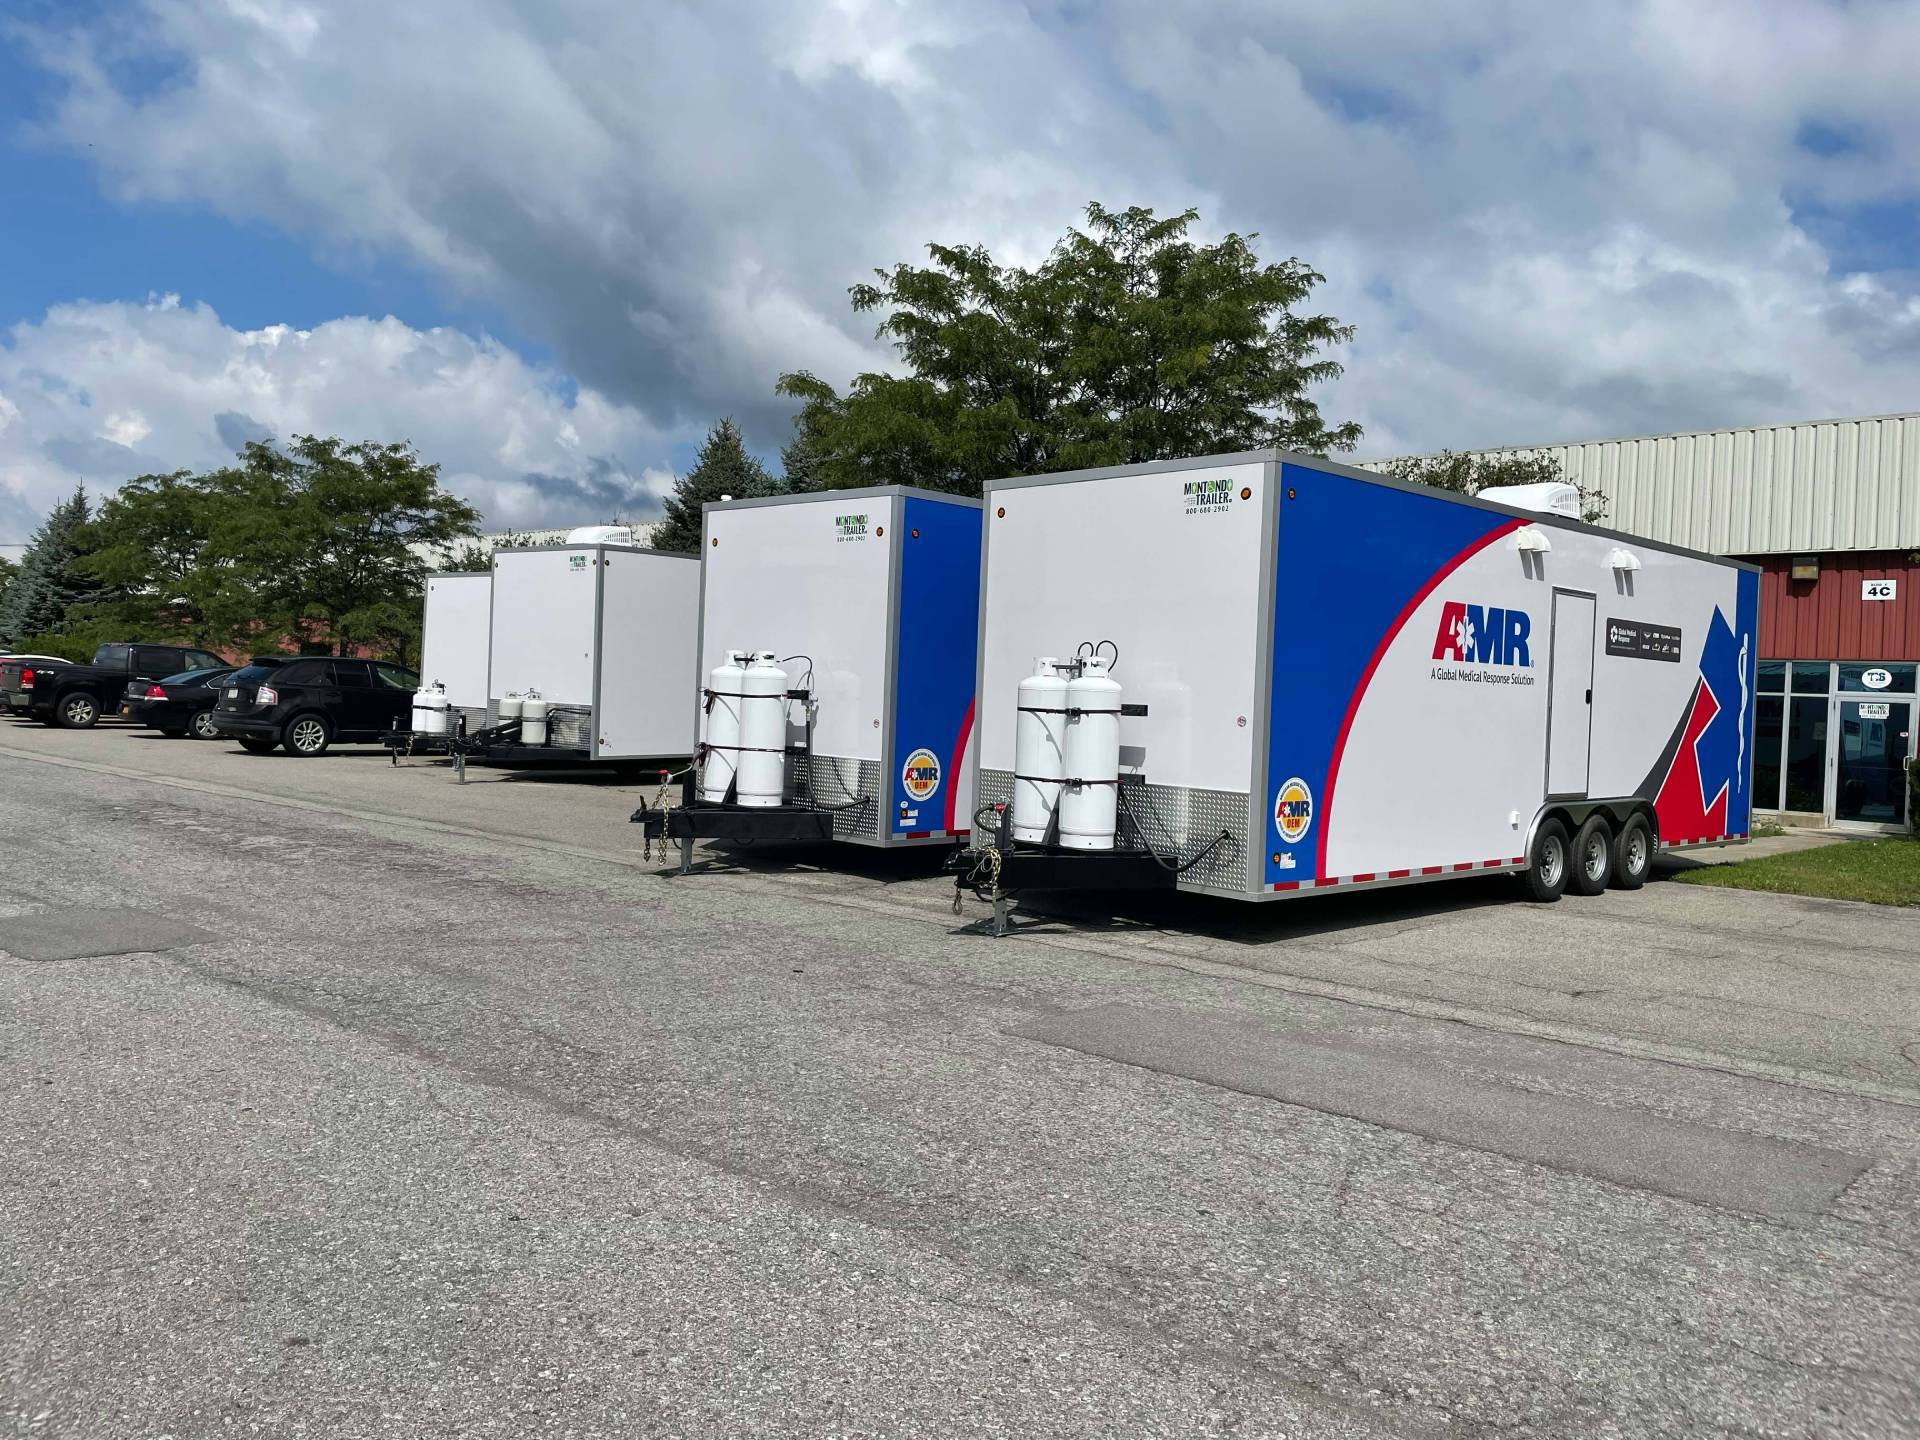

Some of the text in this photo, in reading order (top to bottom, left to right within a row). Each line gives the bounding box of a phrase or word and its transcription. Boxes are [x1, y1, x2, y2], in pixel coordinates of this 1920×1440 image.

[1184, 479, 1233, 495] MONTONDO
[1868, 587, 1891, 596] 4C
[1432, 601, 1531, 667] AMR
[1431, 668, 1534, 686] A Global Medical Response Solution
[904, 768, 938, 780] AMR
[1277, 801, 1311, 818] AMR
